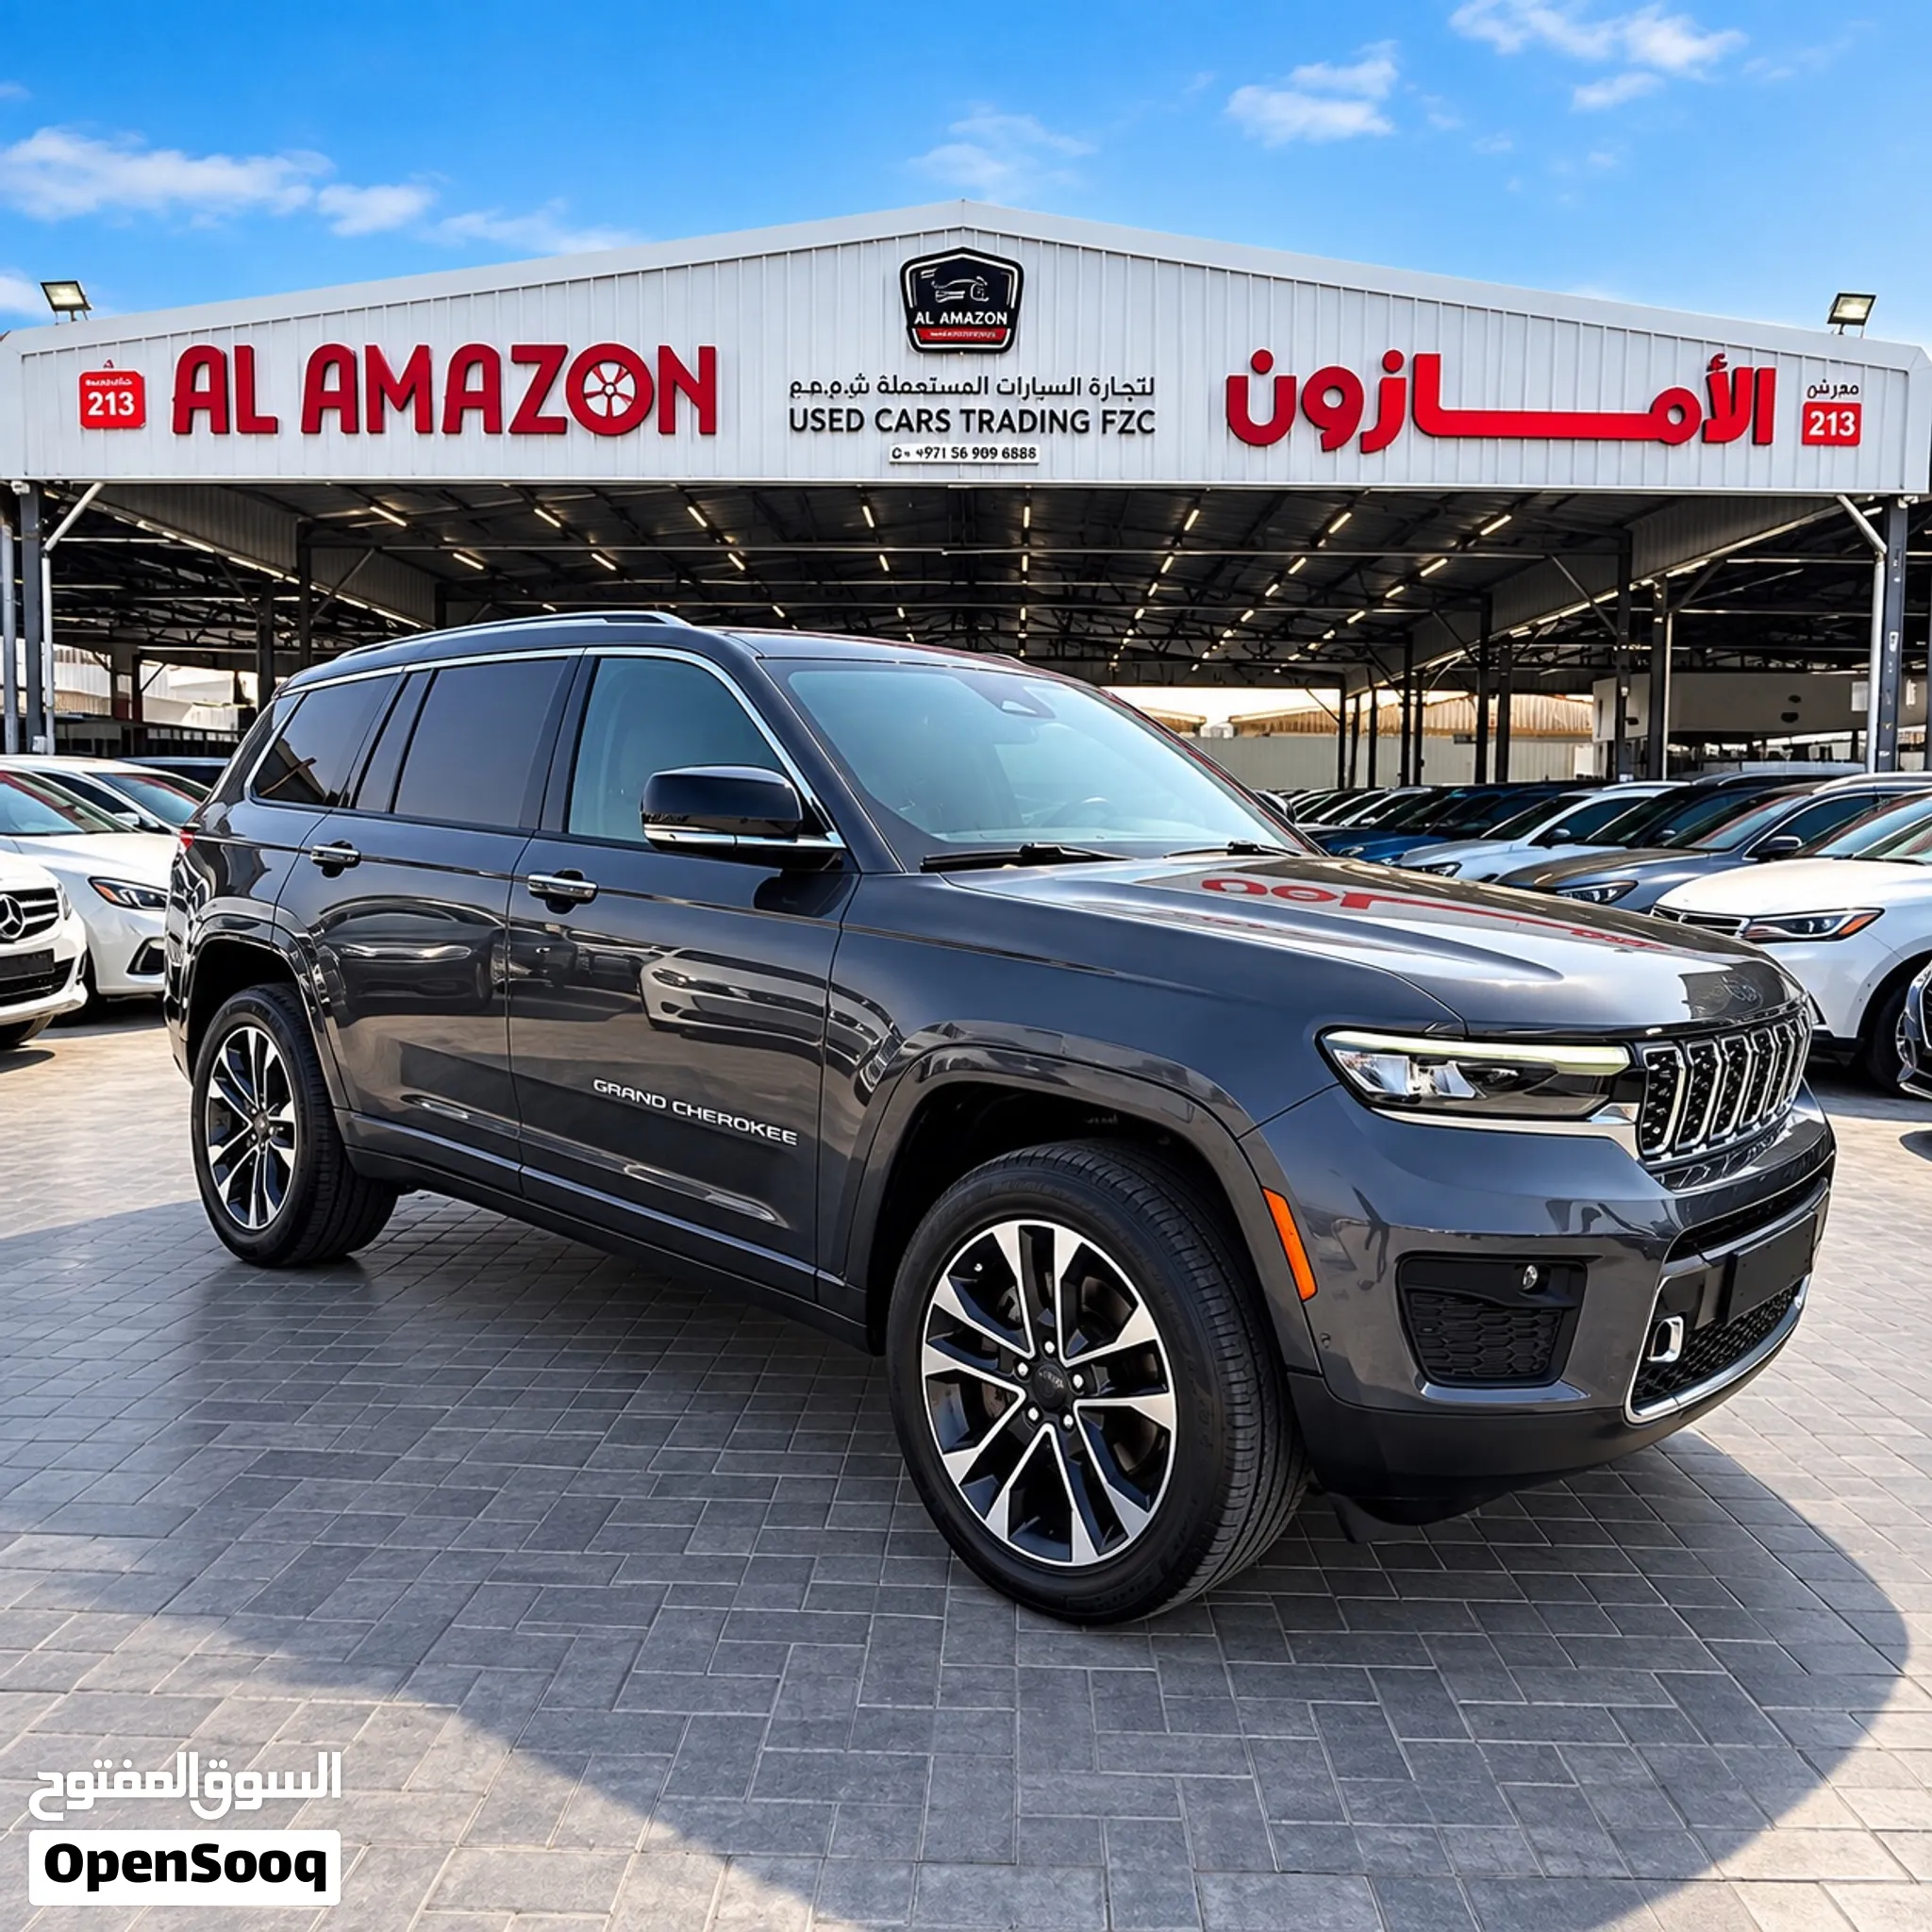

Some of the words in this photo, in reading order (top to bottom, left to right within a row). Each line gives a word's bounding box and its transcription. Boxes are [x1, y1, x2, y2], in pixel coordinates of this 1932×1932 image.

[913, 311, 935, 325] AL
[940, 311, 1008, 325] AMAZON
[172, 344, 278, 435] AL
[301, 343, 717, 436] AMAZON
[876, 374, 989, 395] المستعملة
[996, 375, 1082, 401] السيارات
[1089, 375, 1155, 402] لتجارة
[87, 391, 136, 417] 213
[1225, 348, 1777, 454] الأمازون
[789, 408, 866, 433] USED
[874, 408, 952, 433] CARS
[959, 408, 1091, 434] TRADING
[1101, 409, 1157, 434] FZC
[1808, 410, 1857, 437] 213
[951, 446, 969, 459] 56
[972, 446, 998, 459] 909
[592, 1078, 667, 1109] GRAND
[672, 1101, 799, 1146] CHEROKEE
